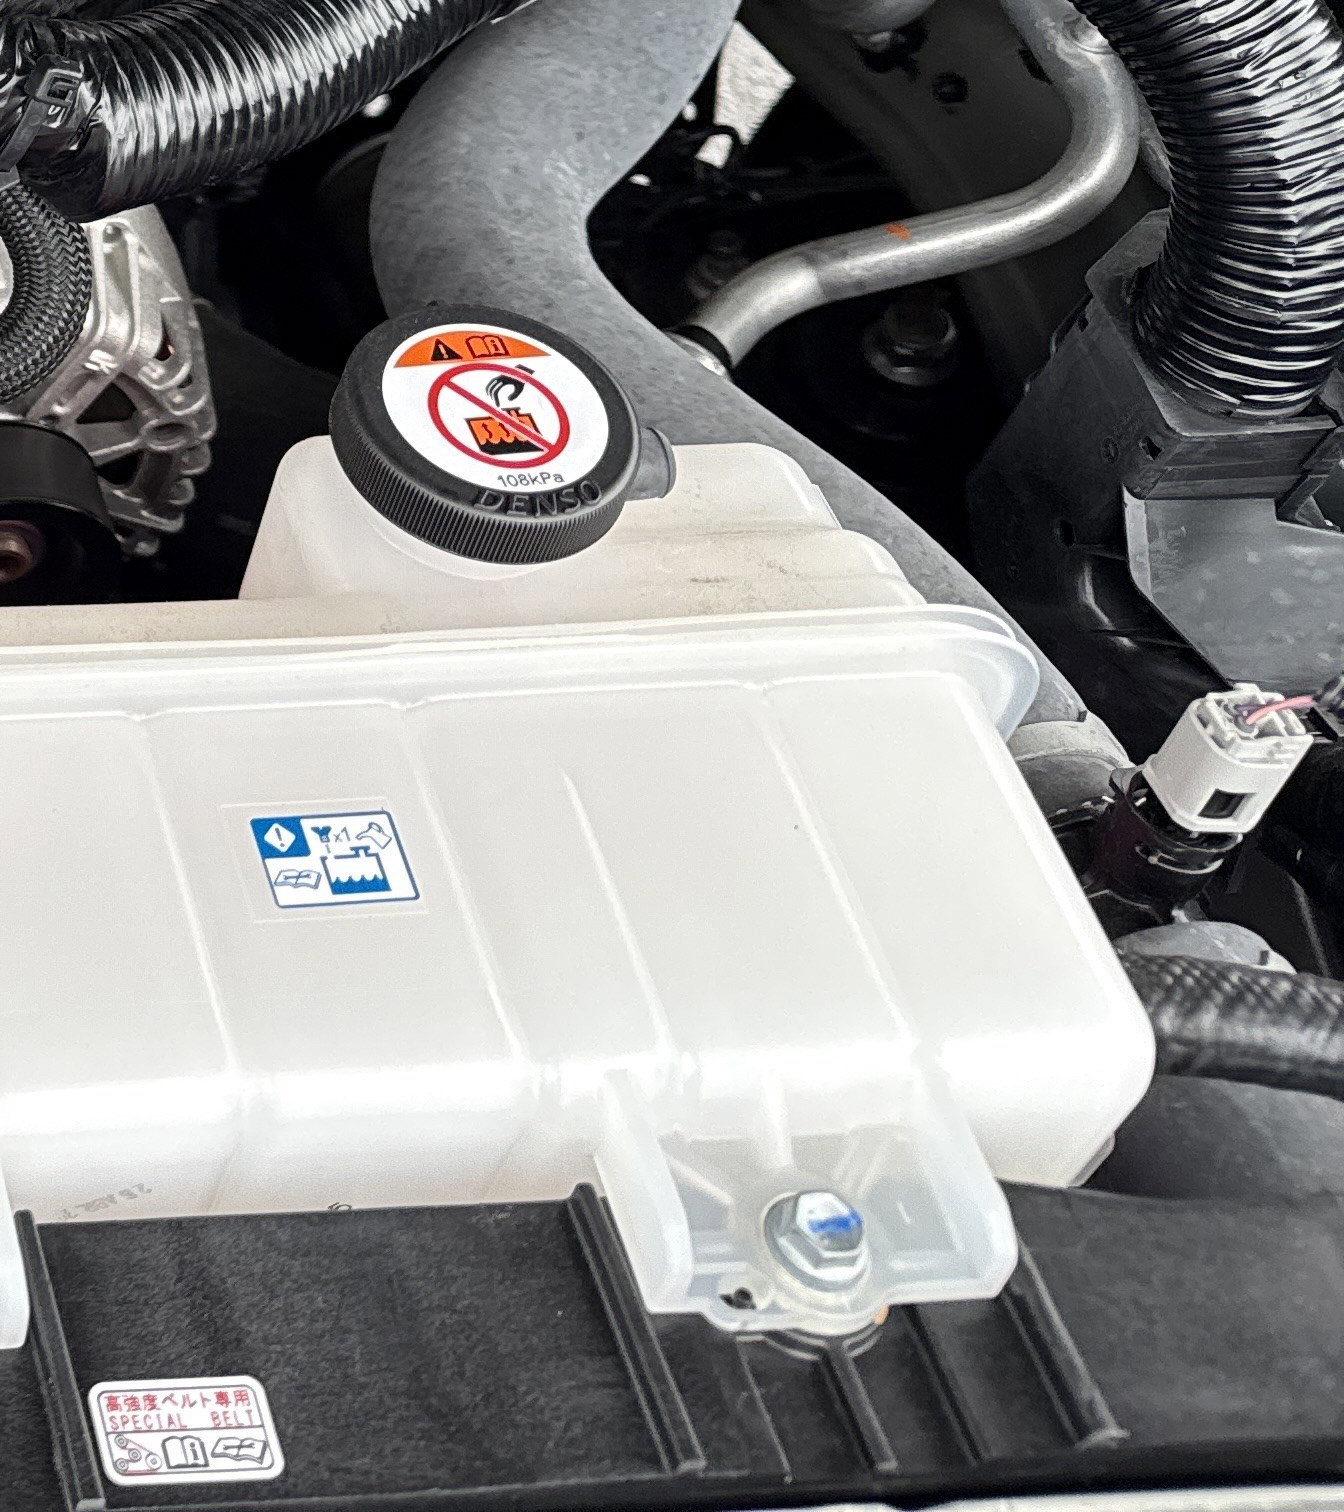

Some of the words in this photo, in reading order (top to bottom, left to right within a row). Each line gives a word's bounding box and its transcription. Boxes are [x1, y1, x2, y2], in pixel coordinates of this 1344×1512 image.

[497, 472, 565, 487] 108kPa
[473, 480, 602, 518] DENSO
[104, 1389, 252, 1412] 高強度ベルト専用
[109, 1413, 188, 1431] SPECIAL
[210, 1409, 254, 1428] BELT
